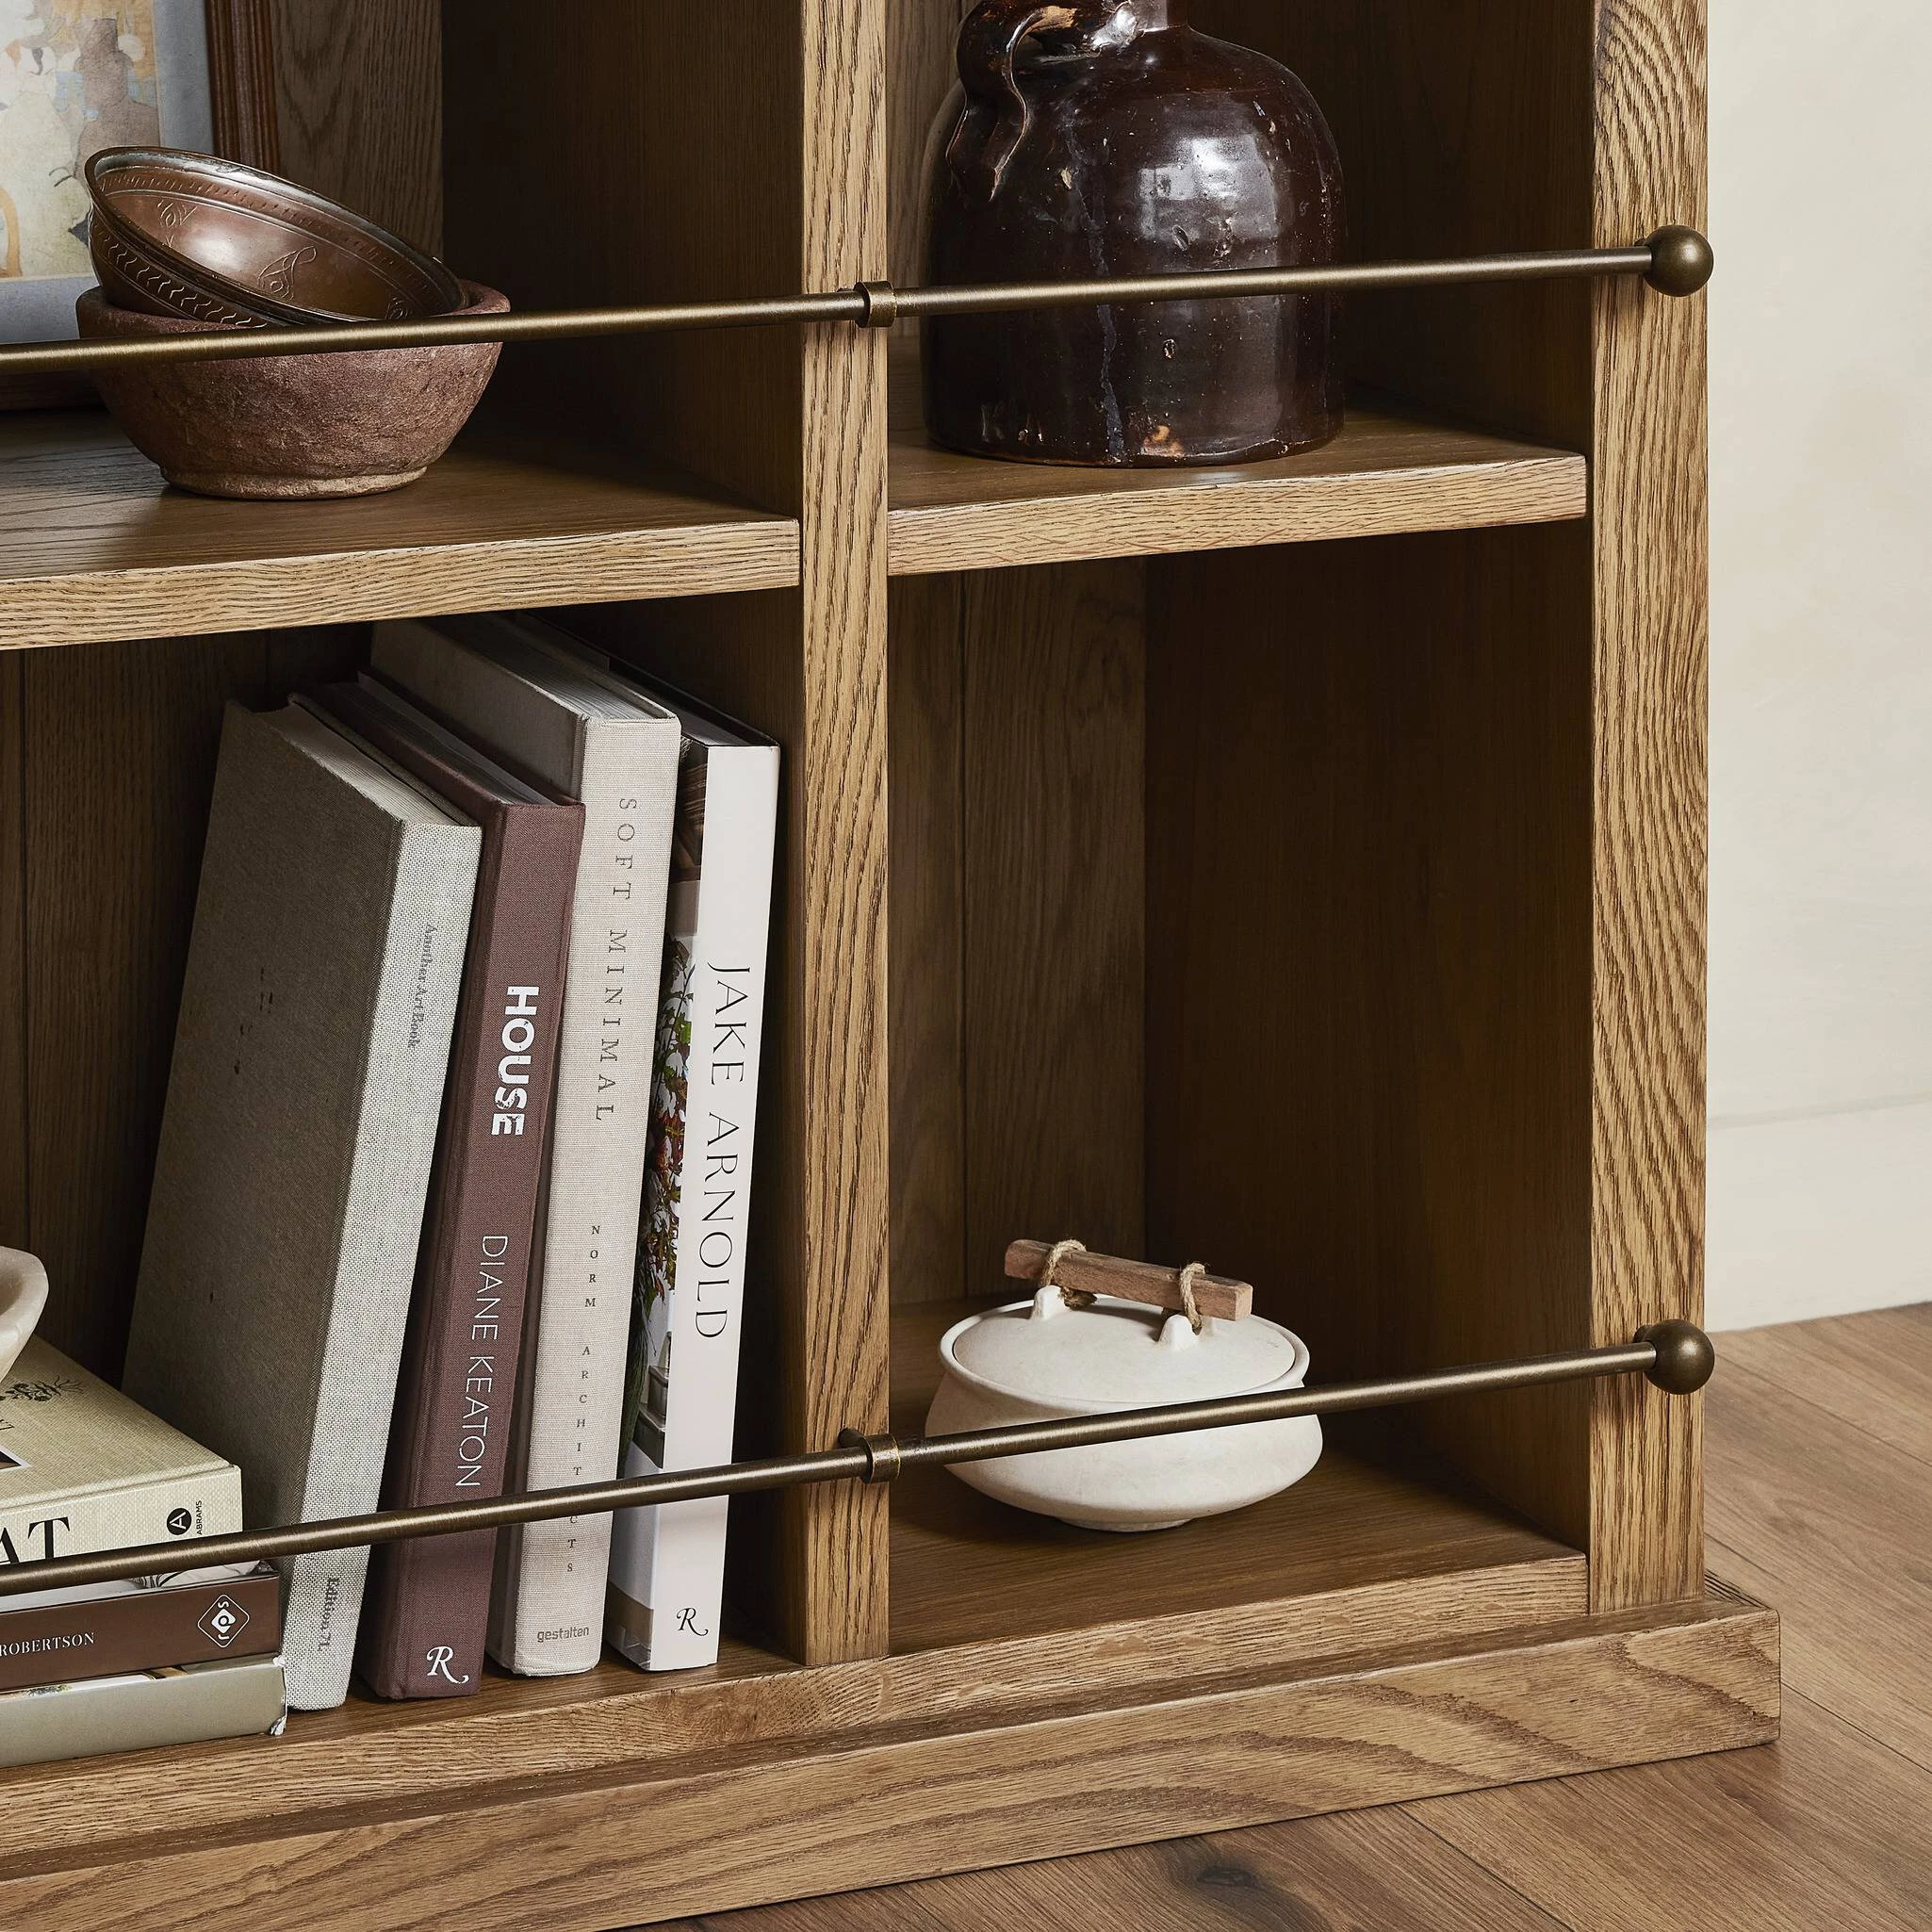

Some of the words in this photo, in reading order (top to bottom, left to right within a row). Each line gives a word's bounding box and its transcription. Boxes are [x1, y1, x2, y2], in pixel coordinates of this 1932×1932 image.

[613, 797, 638, 899] SOFT
[418, 923, 437, 982] Another
[408, 1011, 425, 1048] Book
[414, 984, 428, 1009] Art
[596, 929, 629, 1122] MINIMAL
[708, 961, 751, 1088] JAKE
[491, 986, 540, 1137] HOUSE
[585, 1225, 601, 1308] NORM
[695, 1111, 740, 1339] ARNOLD
[470, 1235, 509, 1341] DIANE
[455, 1354, 496, 1487] KEATON
[565, 1345, 591, 1573] ARCHITCTS
[0, 1632, 95, 1657] ROBERTSON
[320, 1577, 340, 1630] Edition
[536, 1626, 590, 1643] gestalten
[676, 1607, 709, 1636] R
[426, 1645, 469, 1684] R
